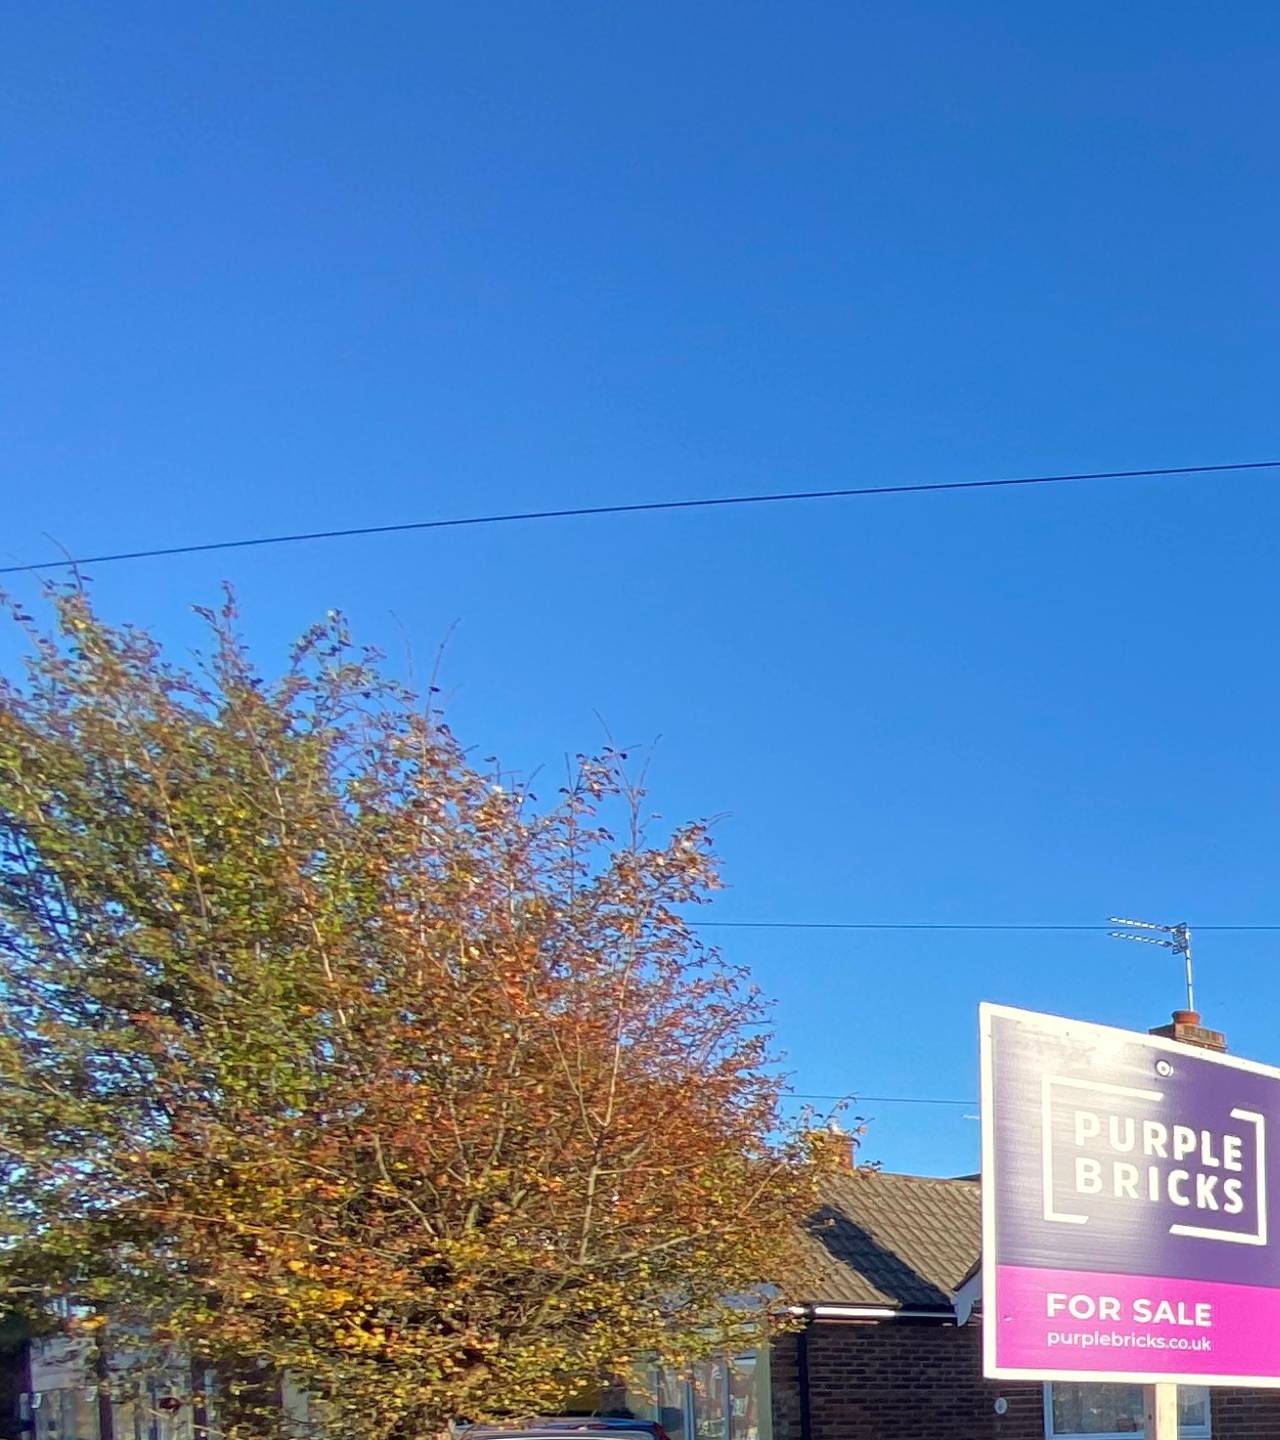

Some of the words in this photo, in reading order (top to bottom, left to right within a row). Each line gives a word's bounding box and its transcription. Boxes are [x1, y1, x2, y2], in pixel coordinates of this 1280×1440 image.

[1074, 1110, 1243, 1172] PURPLE
[1075, 1157, 1244, 1214] BRICKS
[1046, 1293, 1121, 1320] FOR
[1132, 1298, 1212, 1327] SALE
[1047, 1331, 1212, 1351] purplebricks.co.uk
